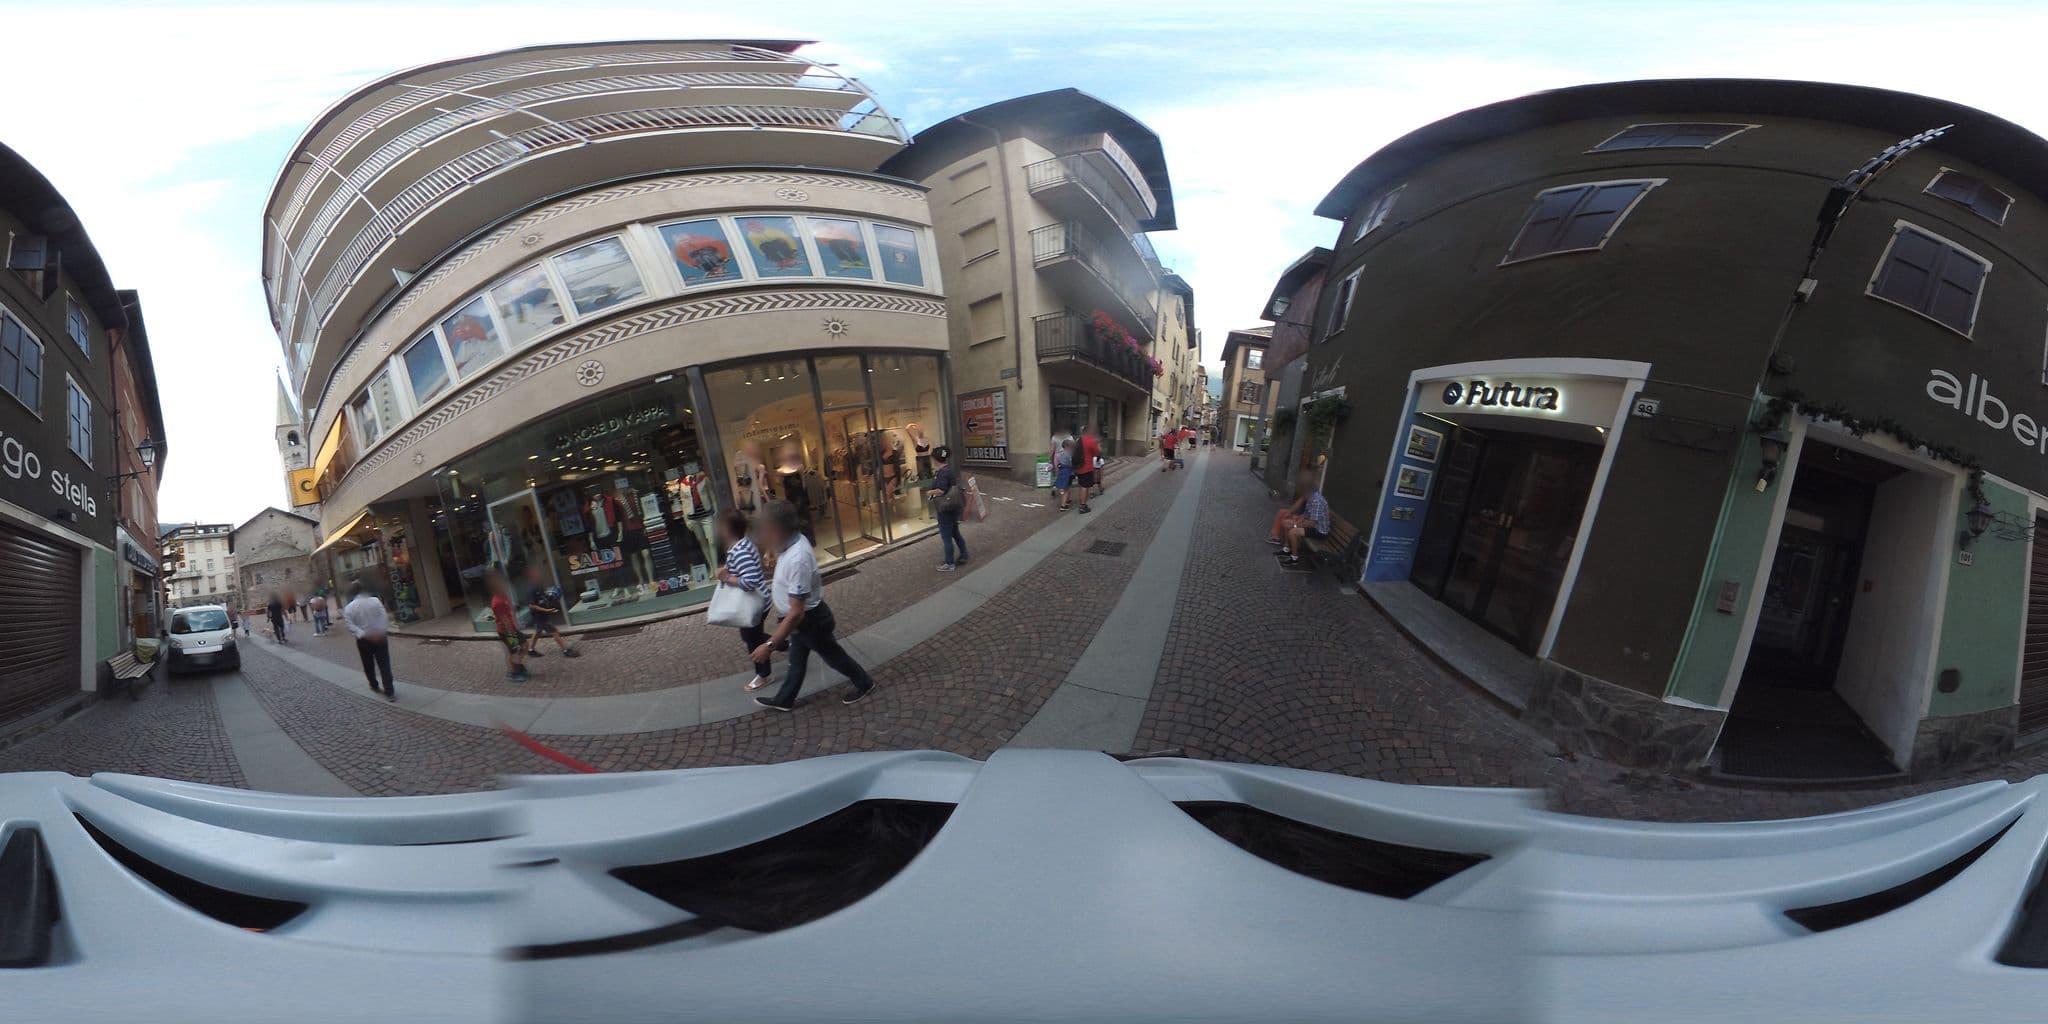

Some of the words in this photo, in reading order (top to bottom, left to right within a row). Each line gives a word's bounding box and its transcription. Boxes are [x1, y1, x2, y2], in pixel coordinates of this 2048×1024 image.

[1465, 380, 1560, 411] Futura
[626, 407, 668, 426] KAPPA
[966, 446, 1006, 460] LIBRERIA
[51, 470, 97, 518] stella
[568, 546, 623, 571] SALDI
